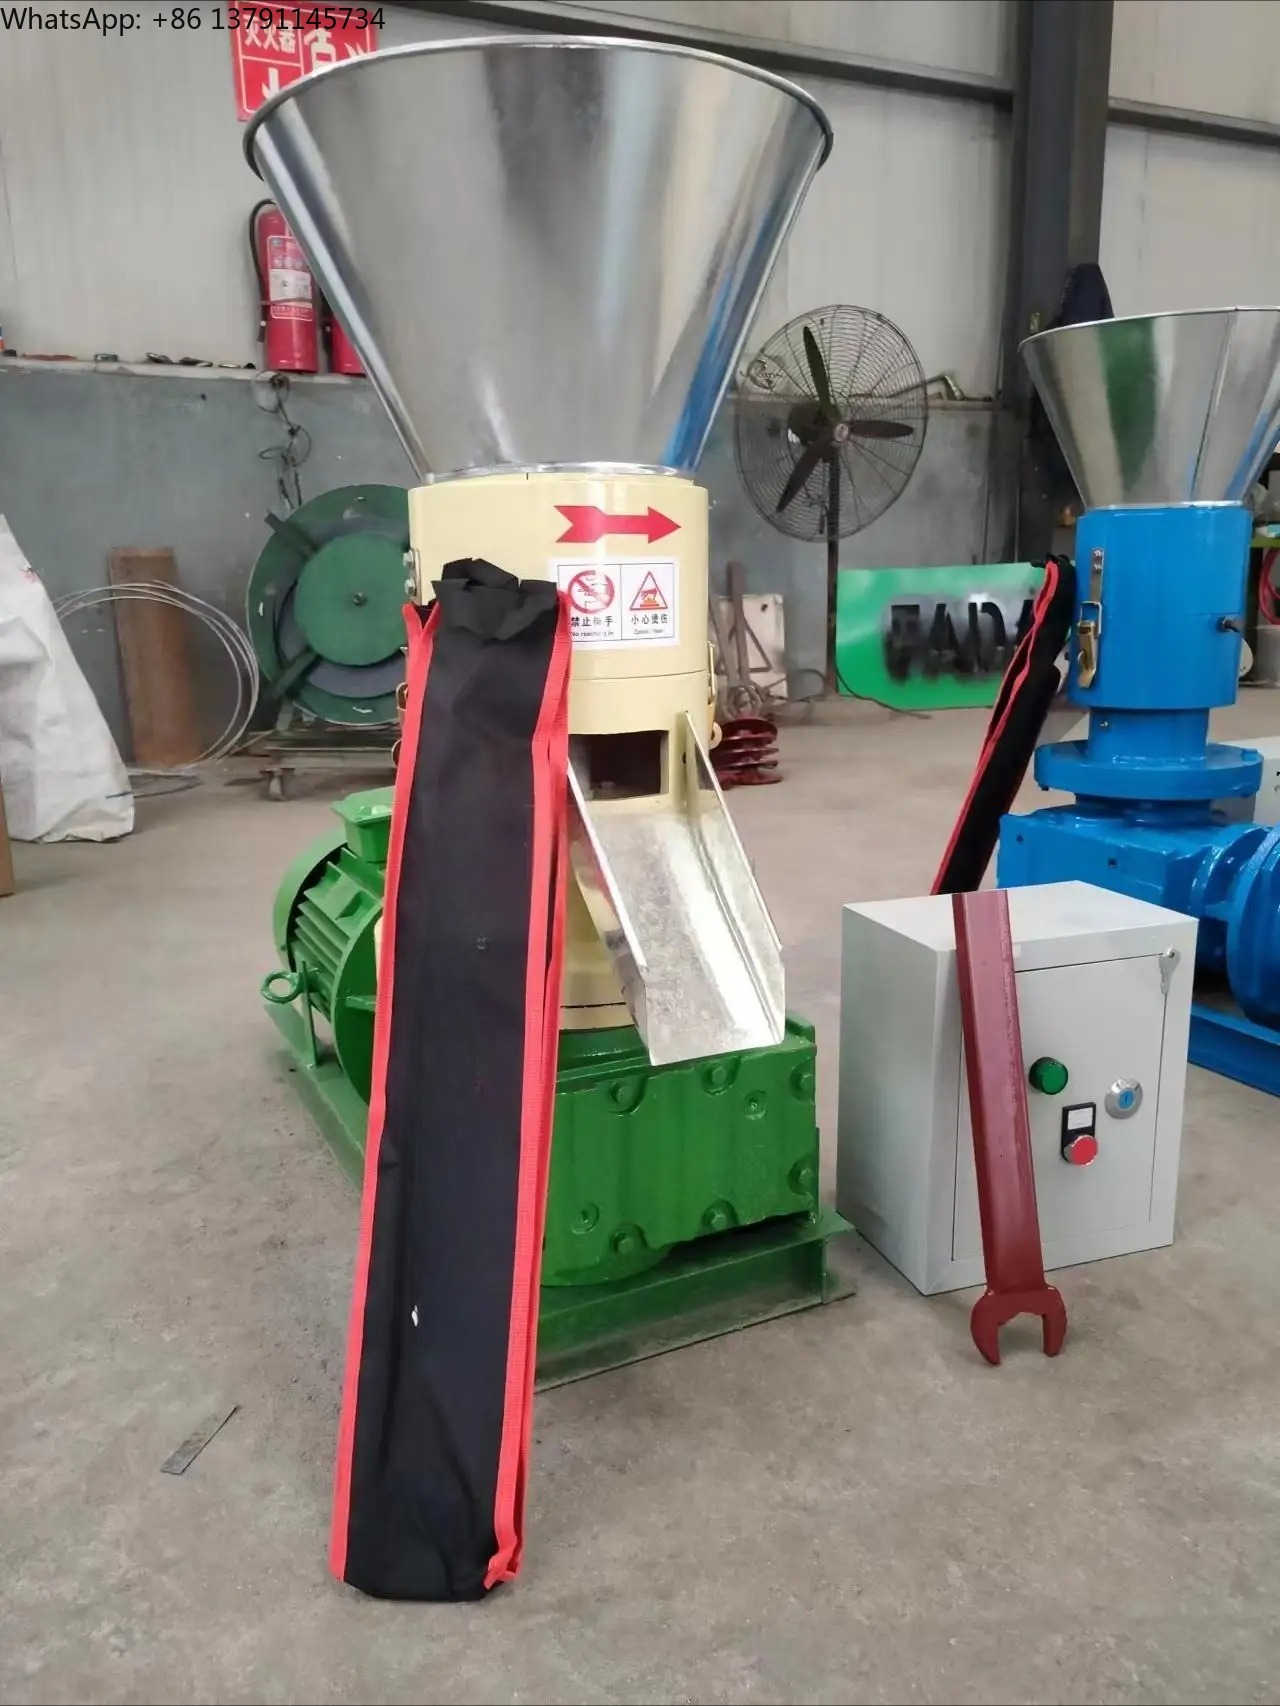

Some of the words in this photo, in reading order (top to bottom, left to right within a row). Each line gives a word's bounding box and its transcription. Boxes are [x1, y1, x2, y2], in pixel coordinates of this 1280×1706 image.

[242, 14, 296, 54] 灭火器
[631, 613, 668, 625] 小心烫伤
